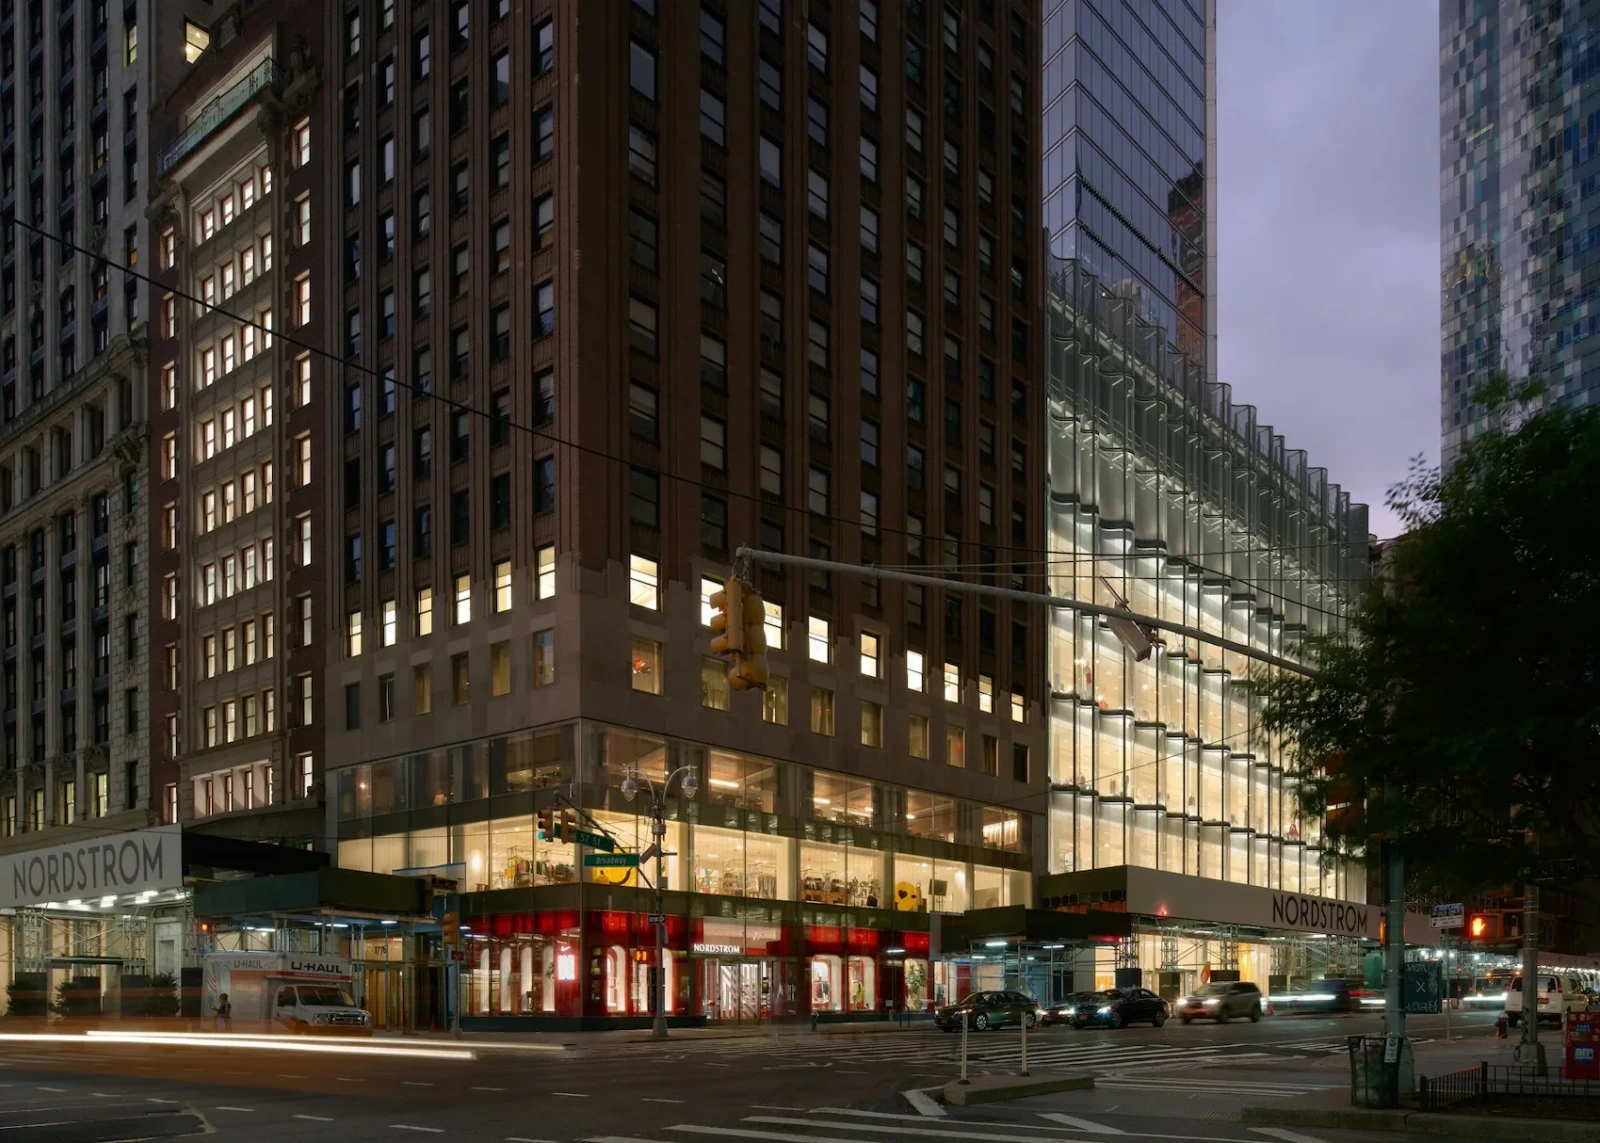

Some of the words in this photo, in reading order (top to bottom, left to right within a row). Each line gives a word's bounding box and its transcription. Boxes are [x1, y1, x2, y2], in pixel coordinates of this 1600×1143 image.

[580, 833, 590, 843] 57
[595, 856, 627, 866] Broadway
[14, 835, 163, 899] NORDSTROM
[1273, 893, 1368, 934] NORDSTROM
[693, 943, 740, 954] NORDSTROM
[234, 959, 263, 969] U-HAUL
[291, 961, 343, 974] U-HAUL
